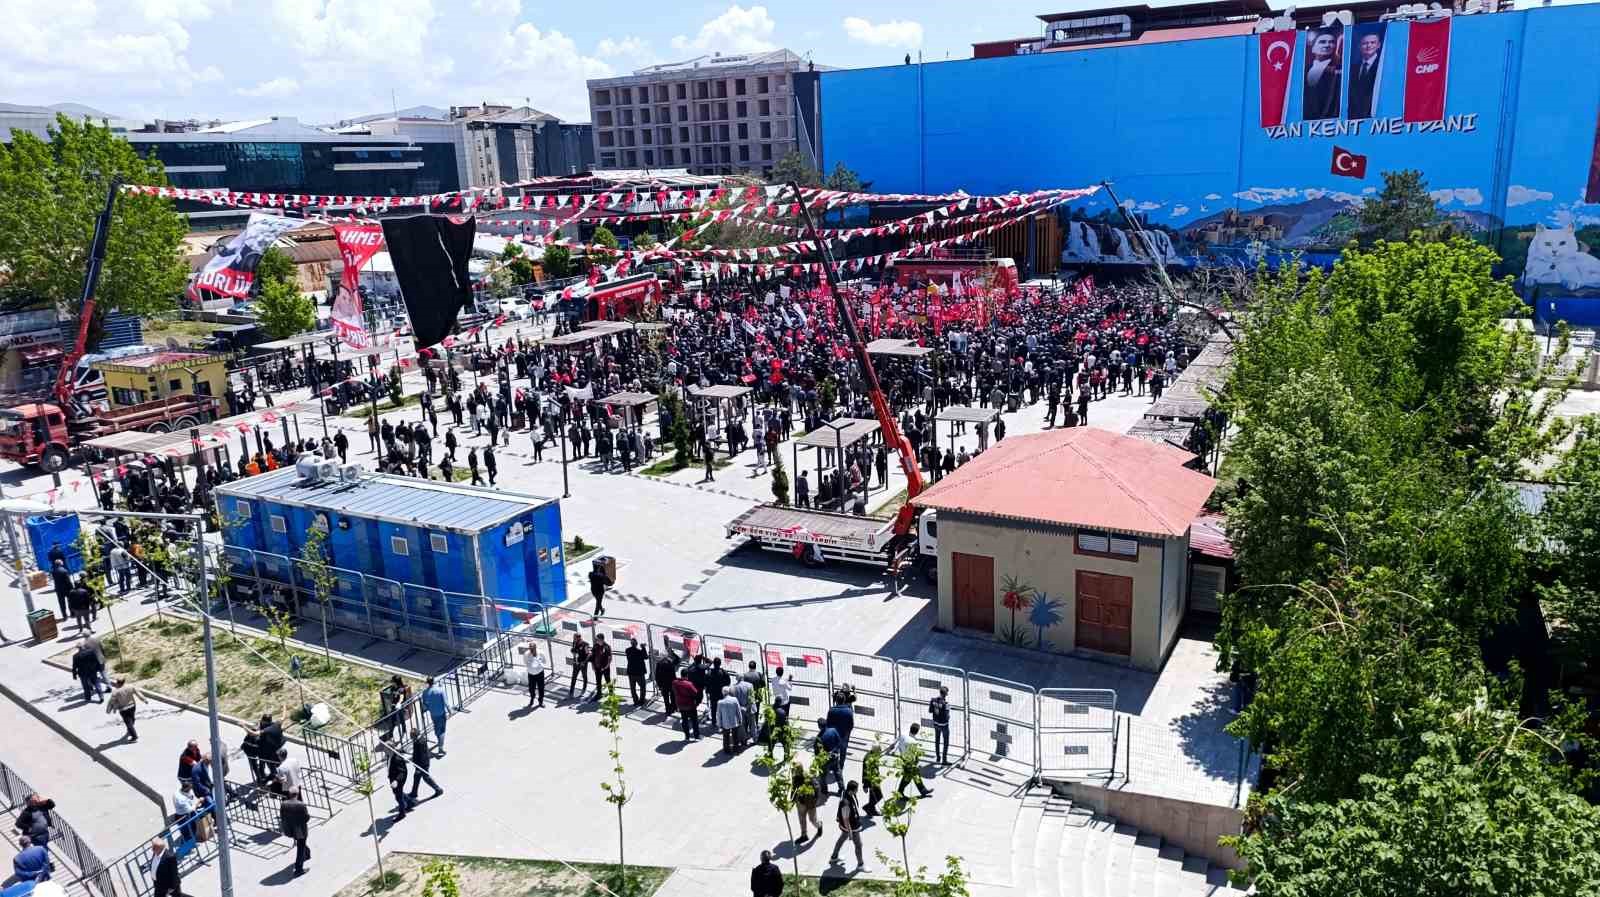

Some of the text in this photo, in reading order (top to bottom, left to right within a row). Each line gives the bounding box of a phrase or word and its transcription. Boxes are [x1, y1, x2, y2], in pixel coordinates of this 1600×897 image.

[1415, 63, 1439, 74] CHP
[1265, 122, 1302, 139] VAN
[1308, 118, 1364, 137] KENT
